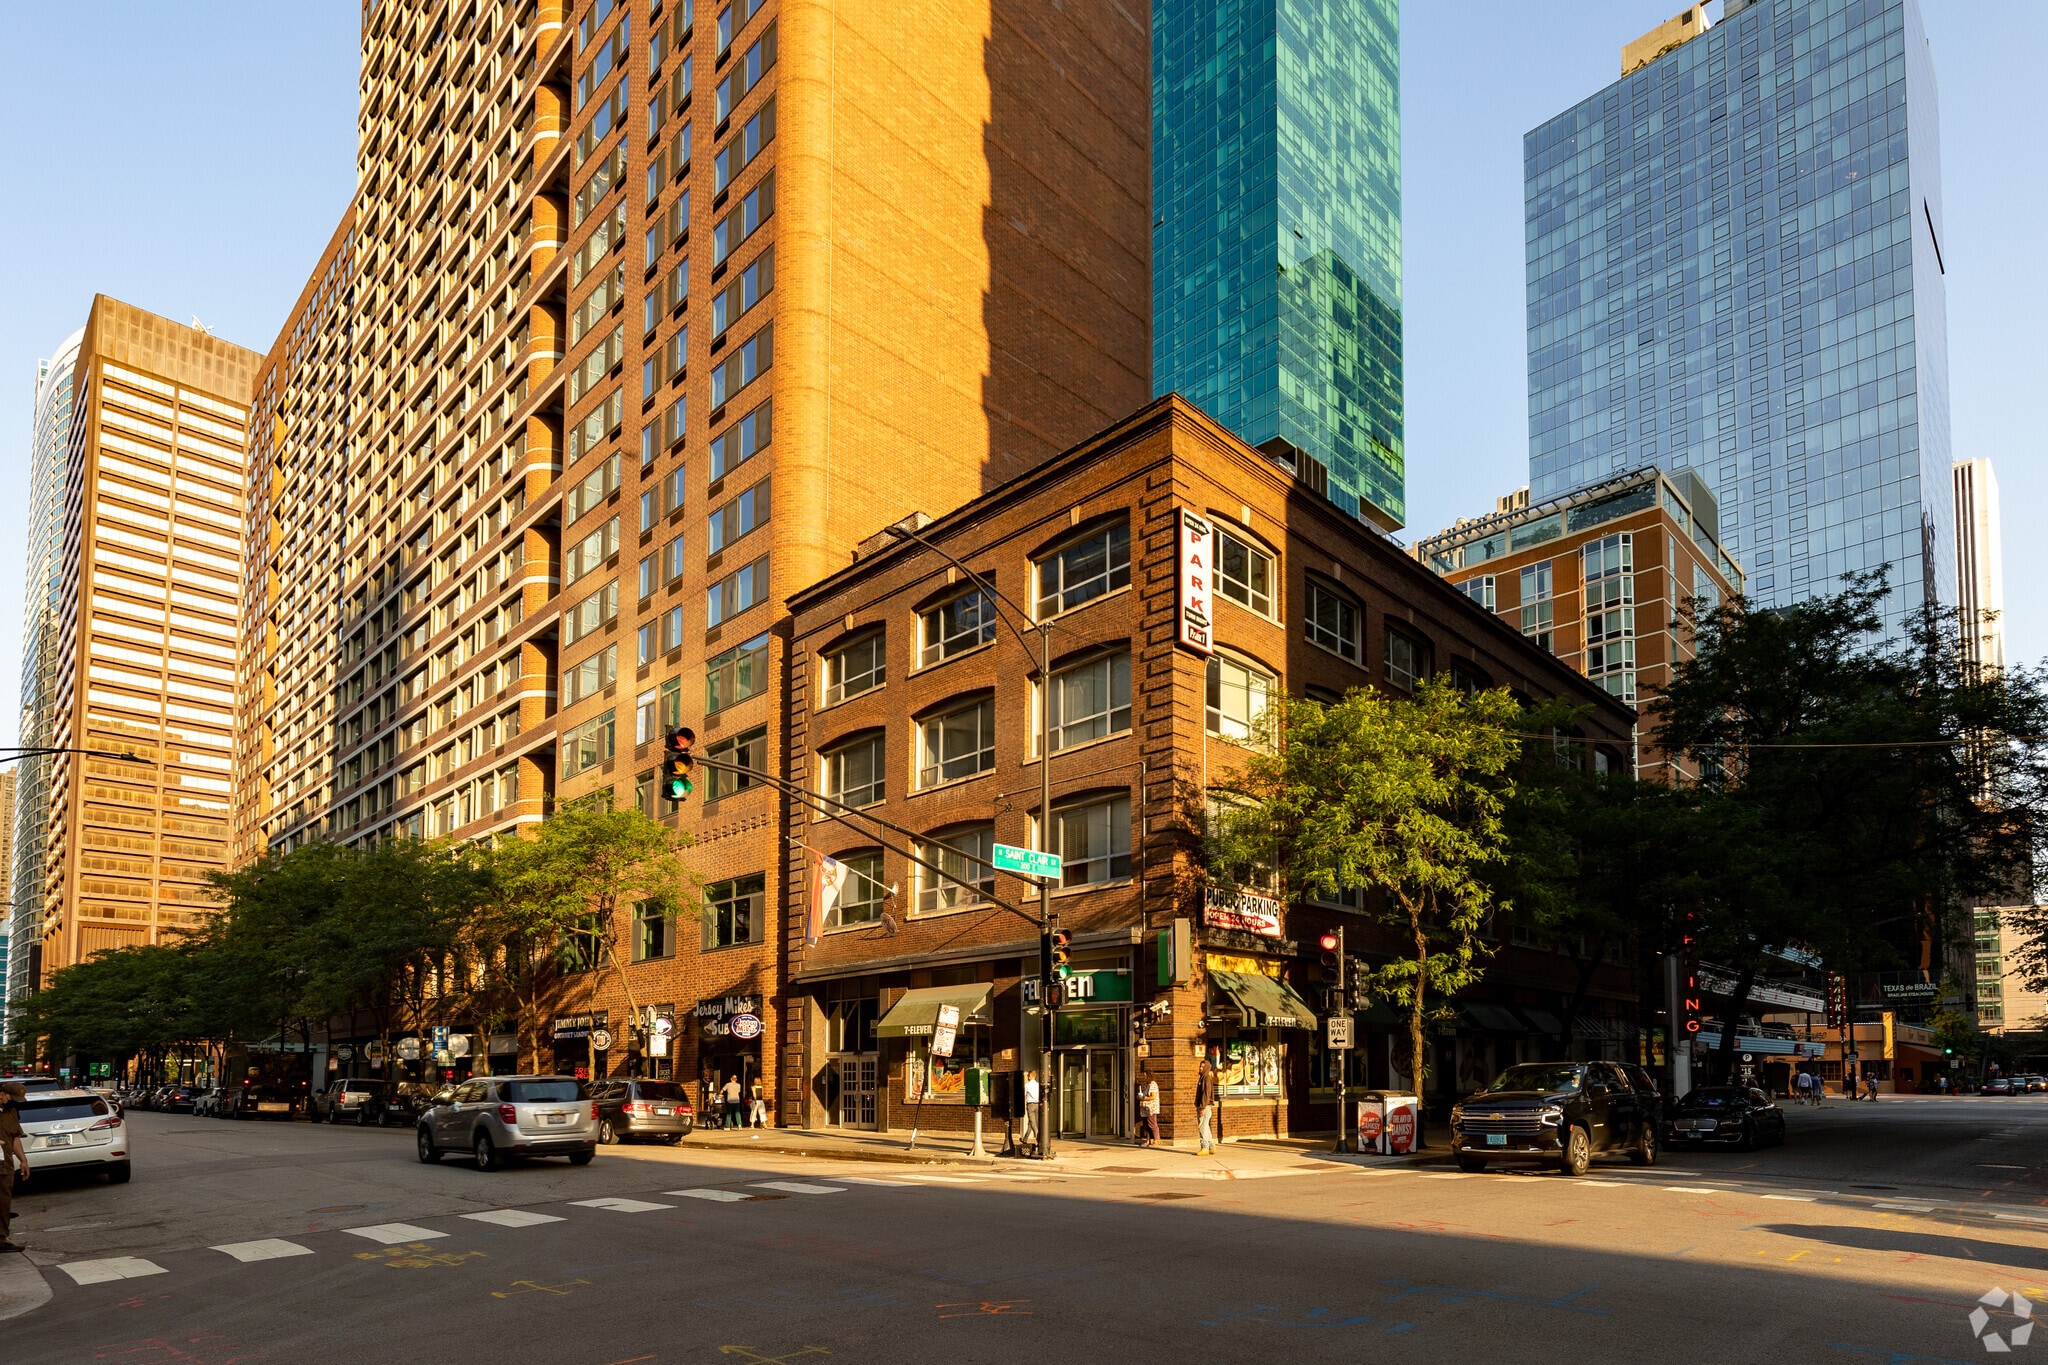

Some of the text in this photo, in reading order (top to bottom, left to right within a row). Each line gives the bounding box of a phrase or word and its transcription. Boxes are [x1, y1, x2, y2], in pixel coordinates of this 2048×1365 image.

[1005, 849, 1025, 862] SAINT
[1028, 853, 1048, 866] CLAIR
[1020, 862, 1030, 871] 200
[1206, 888, 1279, 918] PUBLIC PARKING
[1209, 911, 1267, 928] OPEN 24 HOURS
[1883, 984, 1905, 992] TEXAS
[1914, 982, 1937, 991] BRAZIL
[693, 996, 754, 1020] Jersey Mike's
[555, 1018, 576, 1031] JIMMY
[629, 1014, 645, 1026] TAO
[736, 1018, 757, 1027] Jersey
[1330, 1020, 1346, 1028] ONE
[712, 1020, 730, 1035] SUB
[1330, 1029, 1347, 1037] WAY
[1361, 1122, 1380, 1130] BANKSY
[1392, 1123, 1412, 1136] BANKSY
